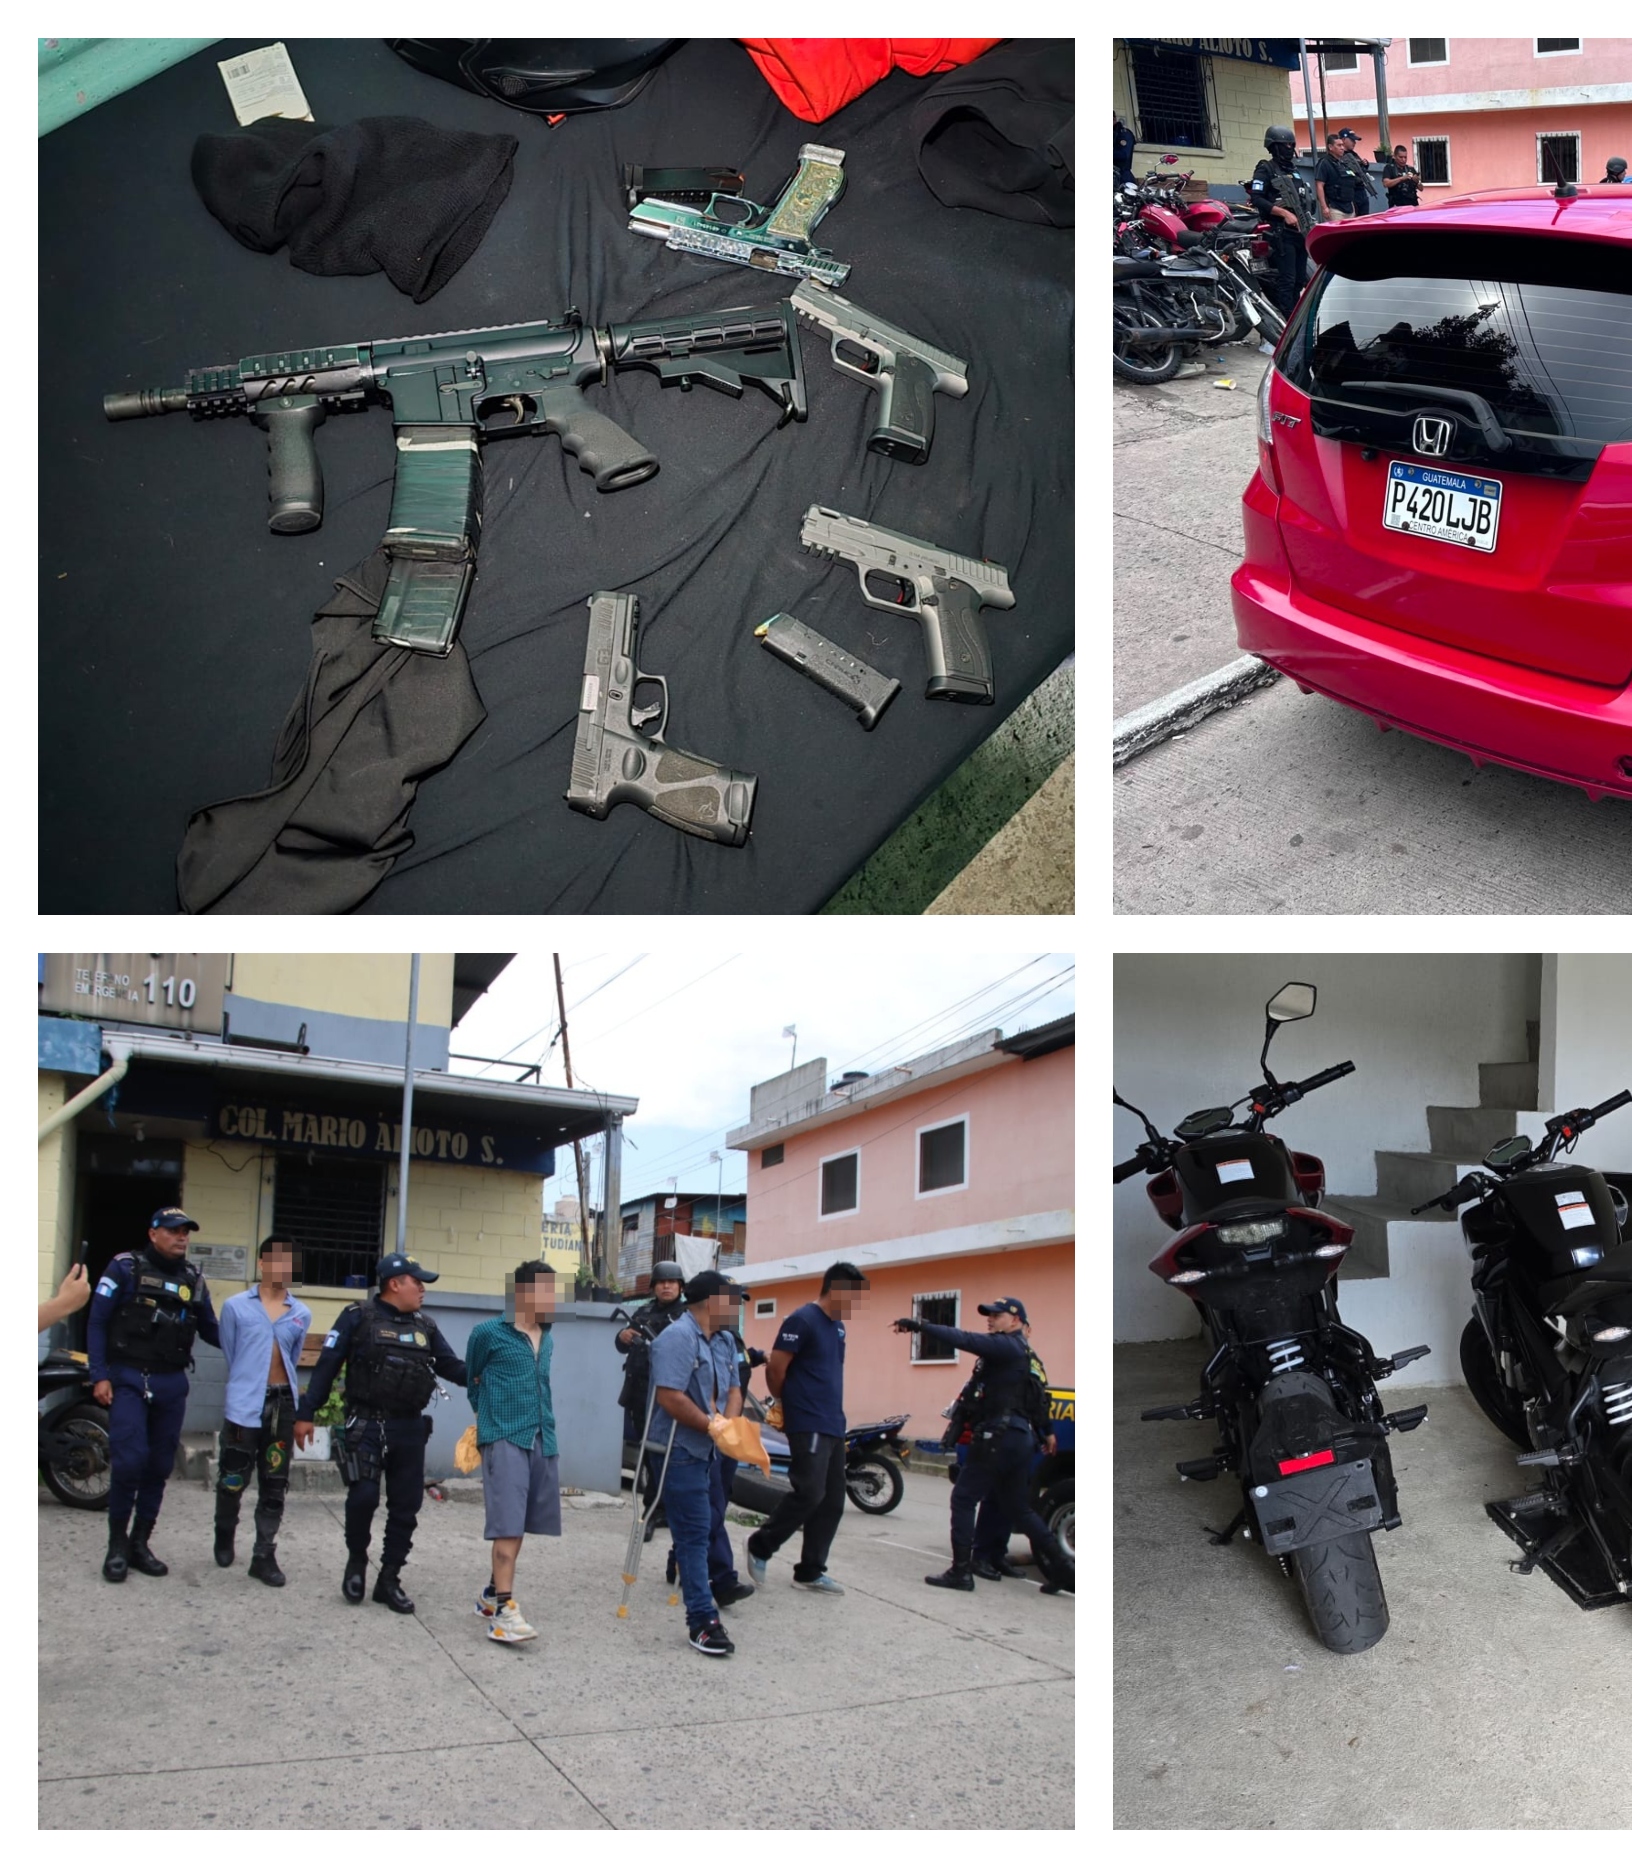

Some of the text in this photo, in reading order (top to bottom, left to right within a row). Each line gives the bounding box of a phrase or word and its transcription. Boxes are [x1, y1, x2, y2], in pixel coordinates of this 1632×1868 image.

[1272, 411, 1301, 428] FIT
[1422, 472, 1467, 489] GUATEMALA
[1391, 481, 1492, 535] P420LJB
[1409, 520, 1438, 535] CENTRO
[75, 968, 131, 986] TELEFNO
[143, 972, 197, 1008] 110
[218, 1104, 276, 1140] COL.
[282, 1110, 367, 1149] MARIO
[480, 1135, 504, 1165] S.
